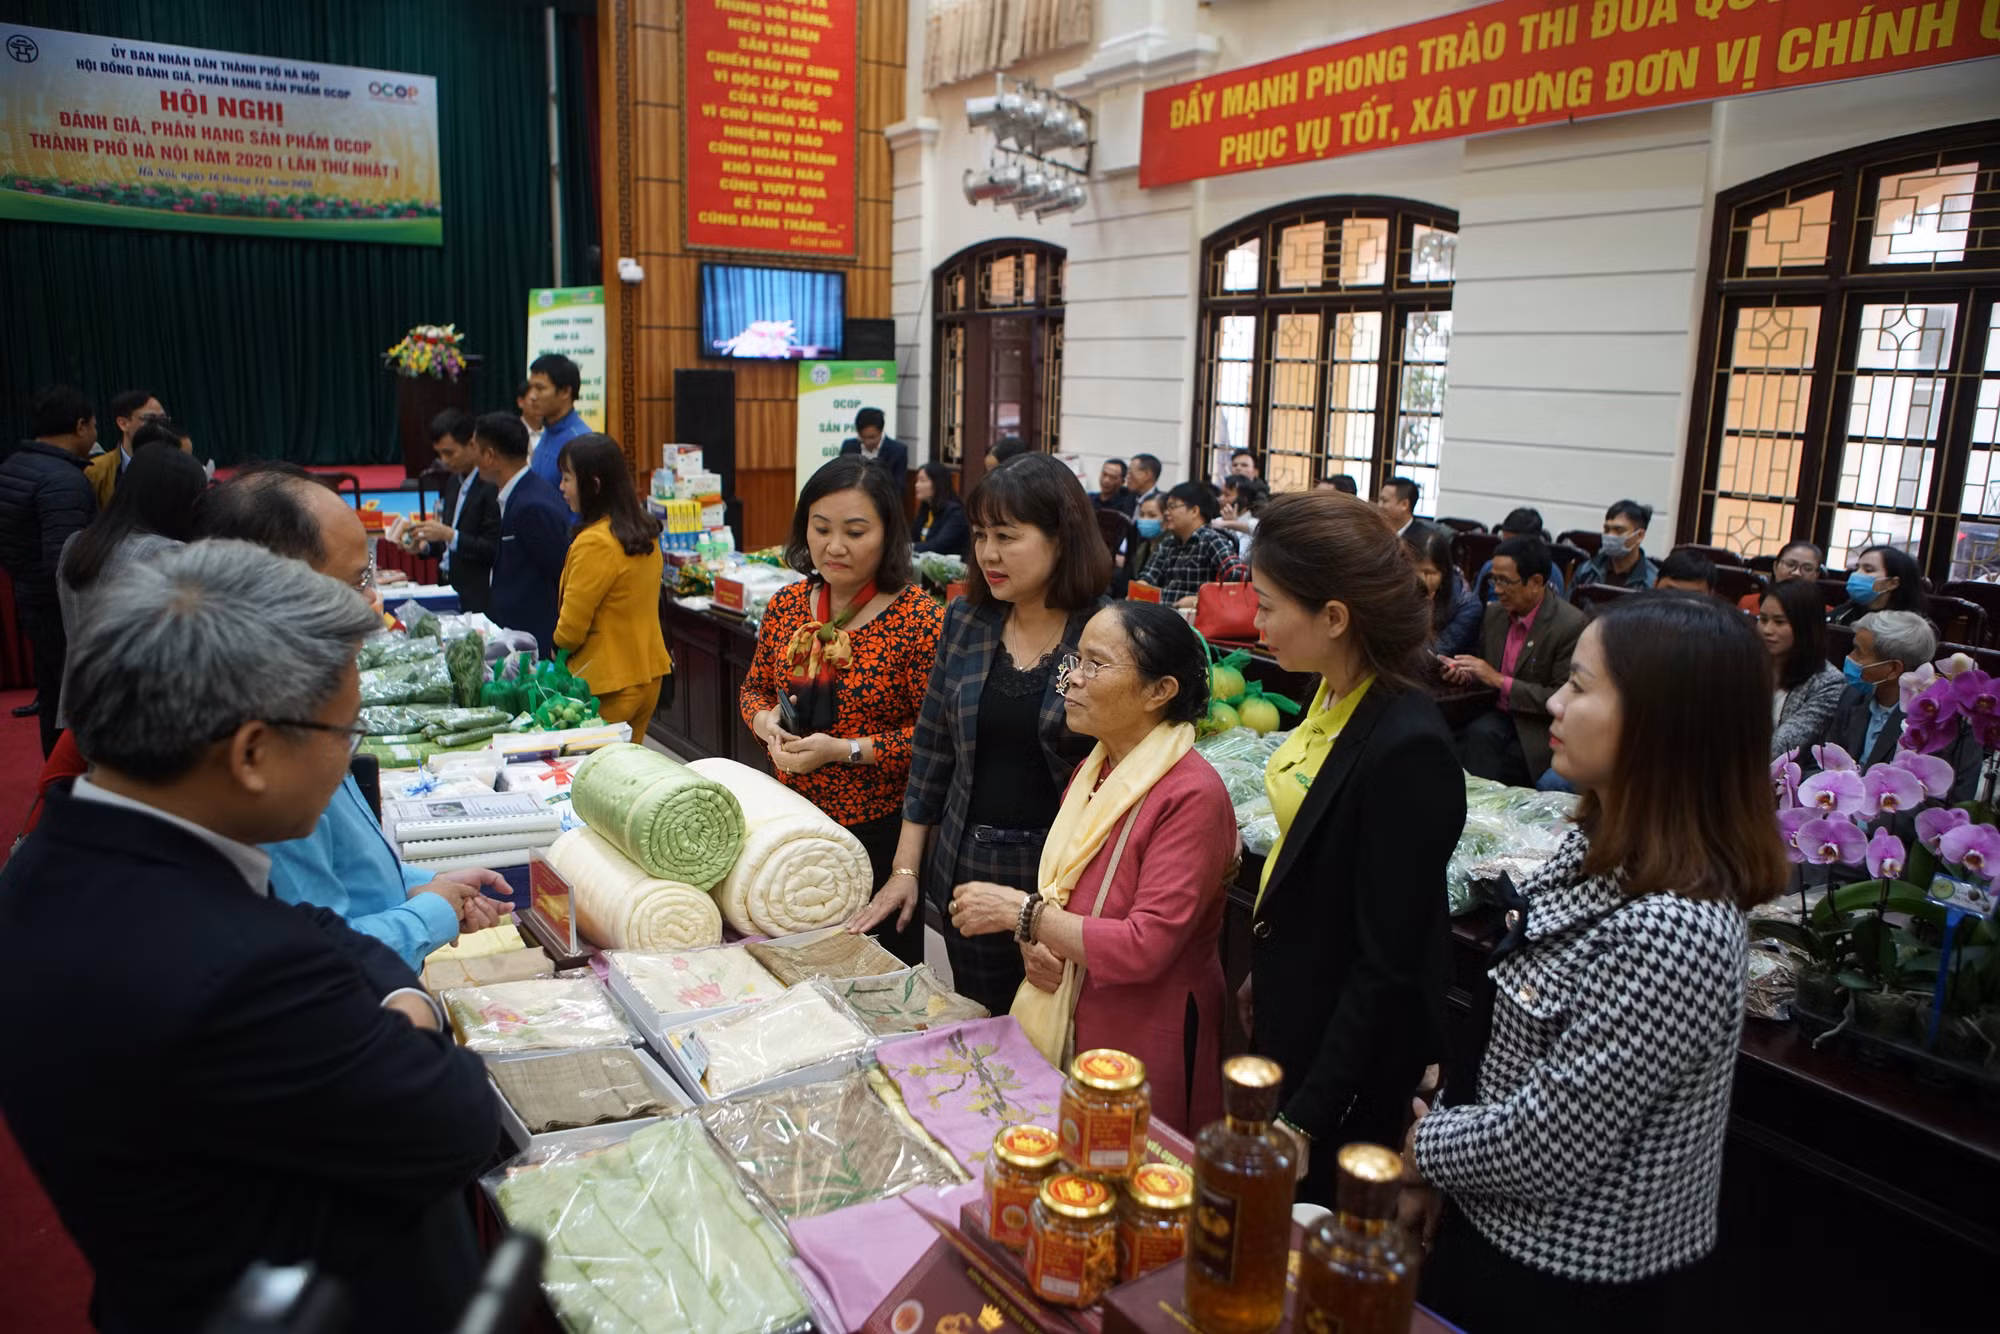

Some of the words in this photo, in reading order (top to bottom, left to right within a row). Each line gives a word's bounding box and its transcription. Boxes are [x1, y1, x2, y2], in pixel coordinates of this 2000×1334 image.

[130, 50, 155, 63] BAN
[158, 53, 191, 67] NHÂN
[194, 57, 218, 70] DÂN
[221, 60, 257, 75] THÀNH
[260, 64, 281, 76] PHỐ
[284, 68, 299, 80] HÀ
[302, 69, 320, 82] NỘI
[806, 65, 840, 81] SINH
[1170, 82, 1214, 129] ĐẨY
[1222, 72, 1298, 119] MẠNH
[1306, 45, 1408, 99] PHONG
[1419, 22, 1506, 75] TRÀO
[1518, 4, 1579, 54] THI
[1590, 0, 1678, 39] ĐUA
[76, 58, 97, 73] HỘI
[100, 59, 134, 76] ĐỒNG
[137, 66, 169, 80] ĐÁNH
[198, 72, 229, 87] PHÂN
[232, 78, 262, 91] HẠNG
[265, 78, 287, 93] SẢN
[290, 81, 321, 97] PHẨM
[324, 88, 352, 100] OCOP
[368, 81, 419, 98] OCOP
[1219, 126, 1287, 168] PHỤC
[1295, 116, 1331, 157] VỤ
[1340, 95, 1400, 146] TỐT,
[1409, 85, 1477, 134] XÂY
[1486, 66, 1594, 124] DỰNG
[1605, 47, 1700, 102] ĐƠN
[1716, 35, 1761, 90] VỊ
[1776, 0, 1960, 74] CHÍNH
[160, 88, 208, 119] HỘI
[217, 96, 284, 128] NGHỊ
[59, 110, 108, 131] ĐÁNH
[113, 116, 147, 136] GIÁ,
[151, 120, 197, 140] PHÂN
[202, 126, 245, 146] HẠNG
[250, 126, 281, 147] SẢN
[286, 130, 329, 151] PHẨM
[334, 137, 372, 155] OCOP
[819, 118, 843, 134] HỘI
[29, 132, 88, 153] THÀNH
[94, 137, 128, 157] PHỐ
[133, 142, 155, 159] HÀ
[160, 144, 189, 163] NỘI
[194, 147, 230, 165] NĂM
[235, 151, 273, 169] 2020
[288, 155, 317, 173] LẦN
[321, 158, 349, 175] THỨ
[352, 160, 389, 177] NHẤT
[138, 166, 153, 177] Hà
[719, 177, 759, 193] CŨNG
[761, 181, 797, 197] VƯỢT
[798, 186, 827, 199] QUA
[833, 400, 862, 409] OCOP
[819, 420, 841, 433] SẢN
